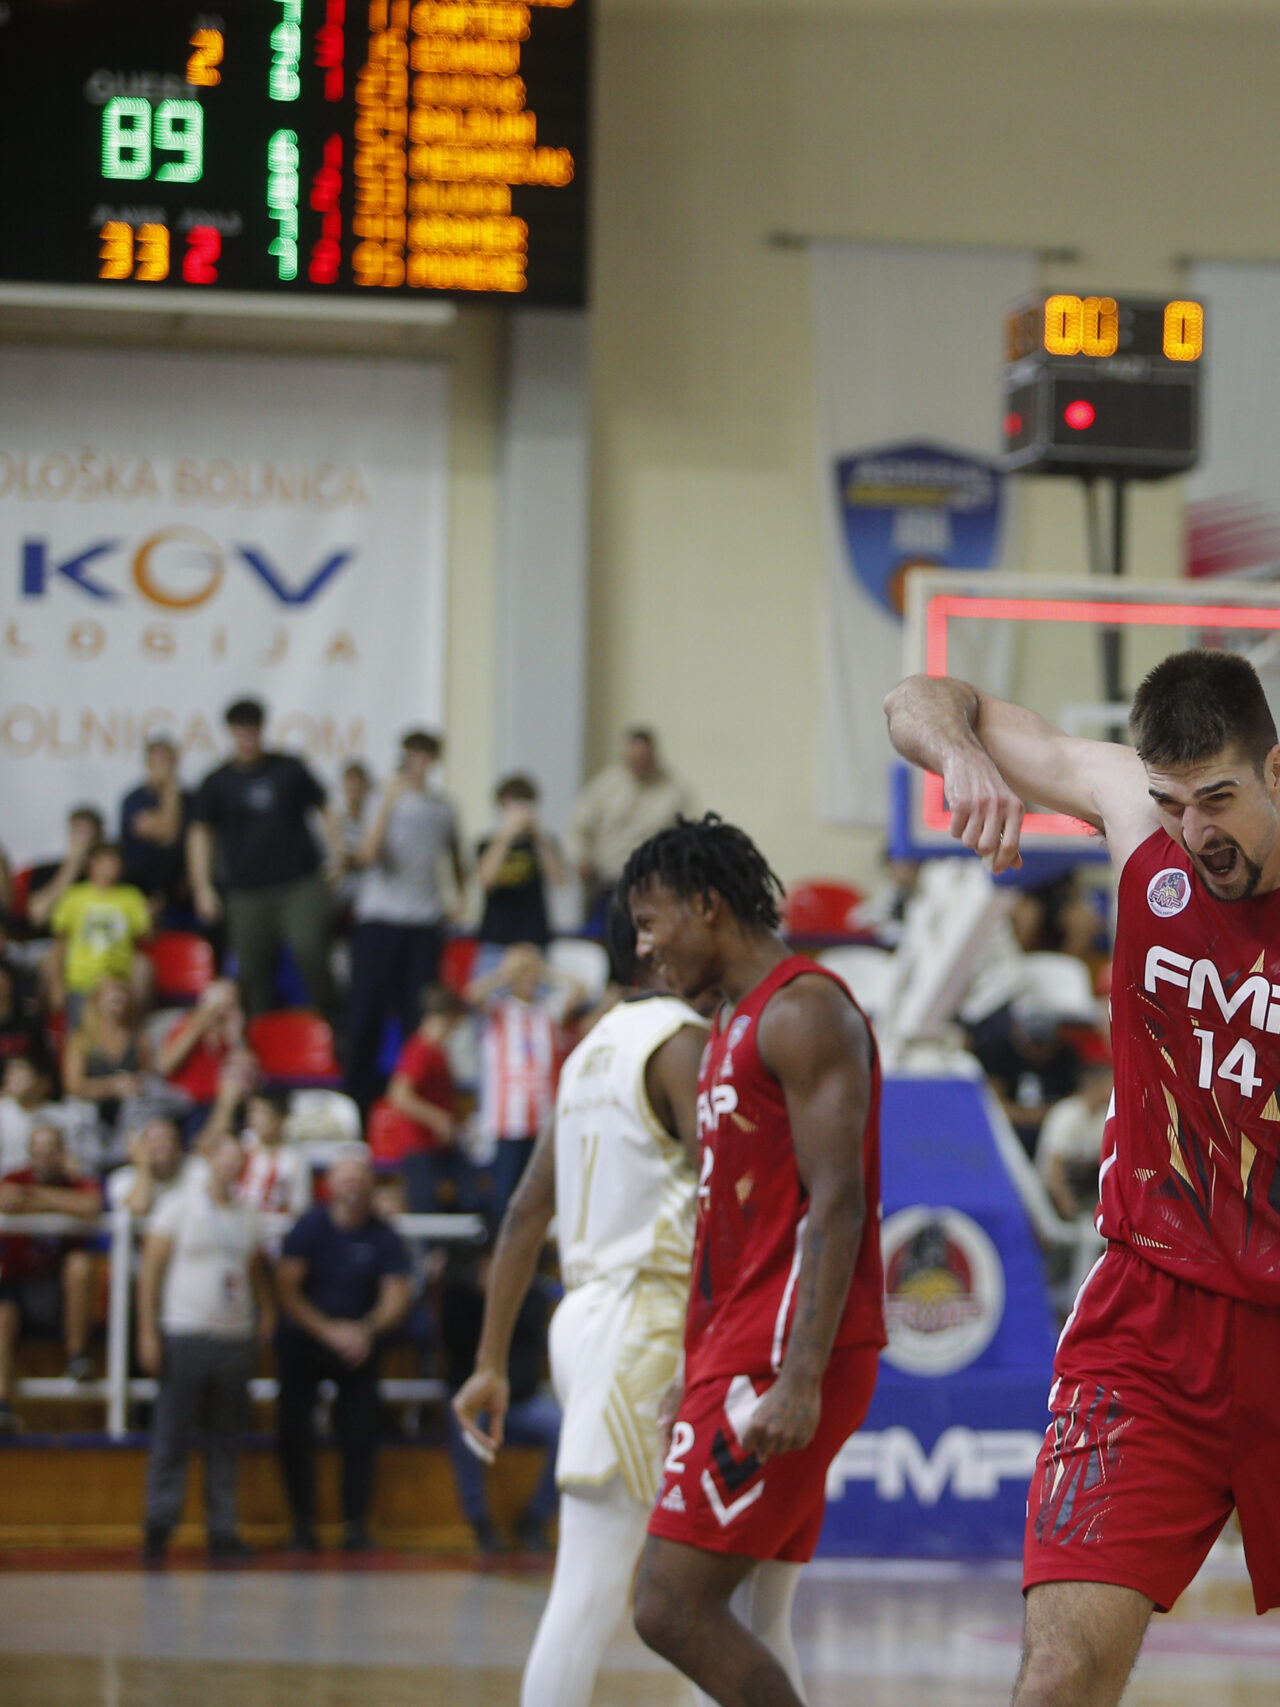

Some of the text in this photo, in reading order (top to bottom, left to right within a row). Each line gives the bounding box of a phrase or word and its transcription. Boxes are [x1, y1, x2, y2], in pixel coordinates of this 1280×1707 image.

[102, 97, 204, 183] 89
[98, 220, 170, 281] 33
[1193, 1029, 1262, 1098] 14
[826, 1426, 1046, 1506] FMP
